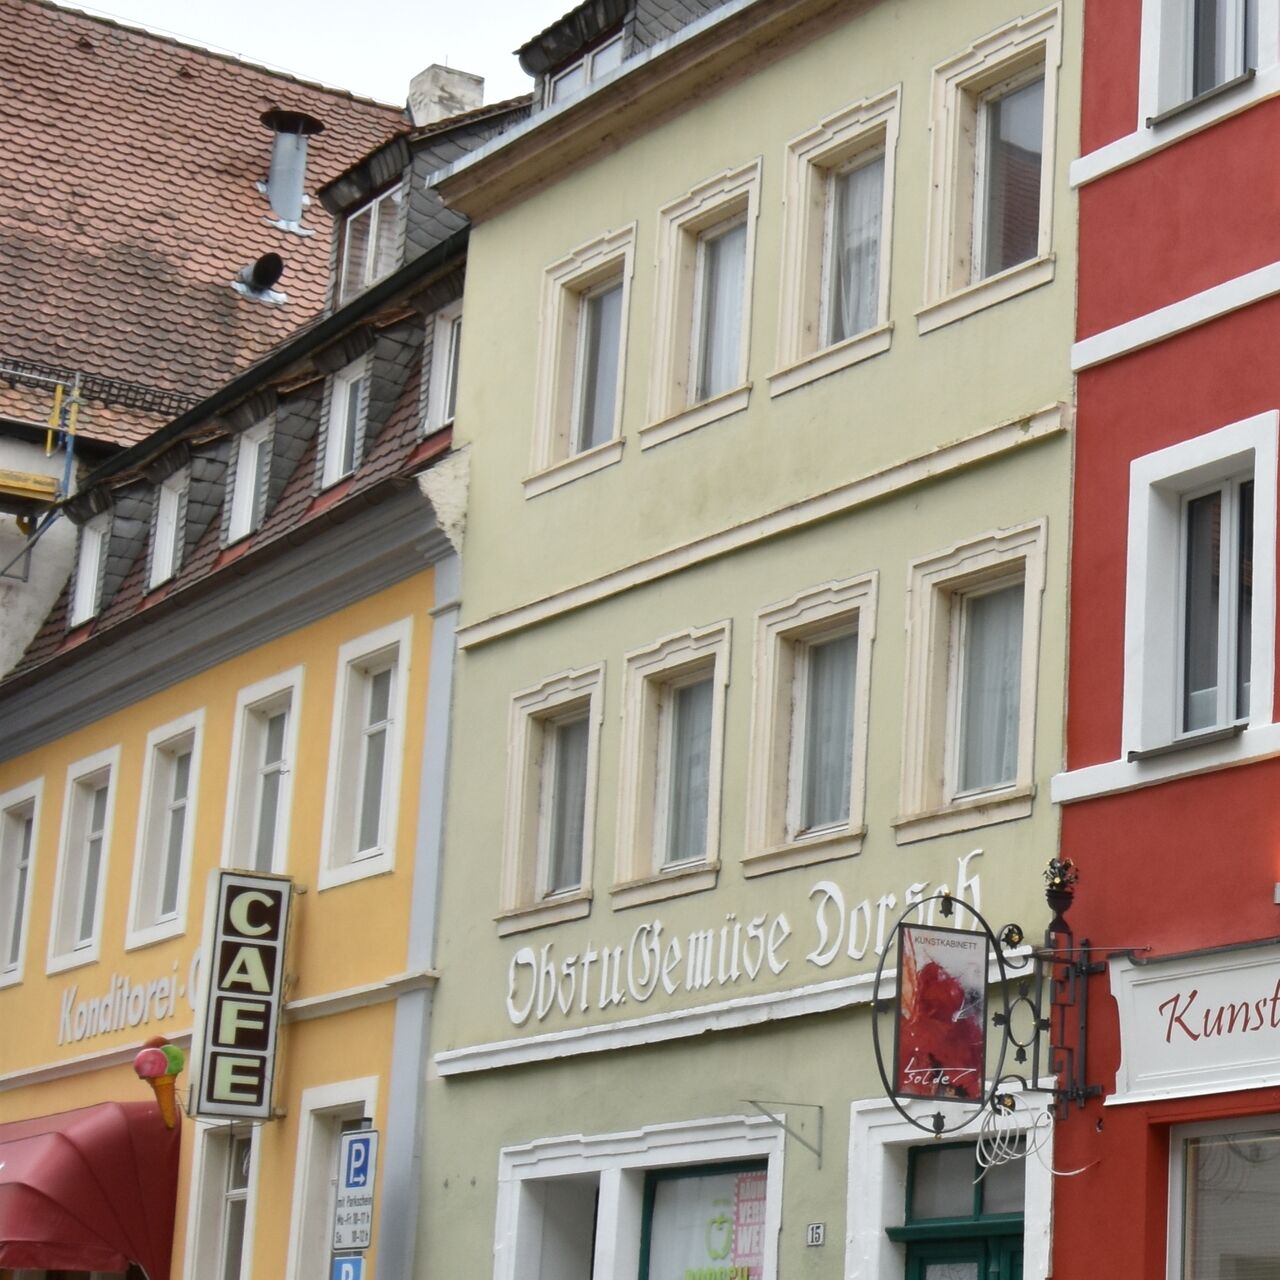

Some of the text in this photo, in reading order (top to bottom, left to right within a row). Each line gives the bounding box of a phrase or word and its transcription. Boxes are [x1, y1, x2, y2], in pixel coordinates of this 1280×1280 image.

[506, 943, 599, 1026] Obst
[627, 912, 793, 1003] Gemüse
[914, 935, 978, 951] KUNSTKABINETT
[212, 891, 276, 1103] CAFE
[810, 1225, 821, 1244] 15
